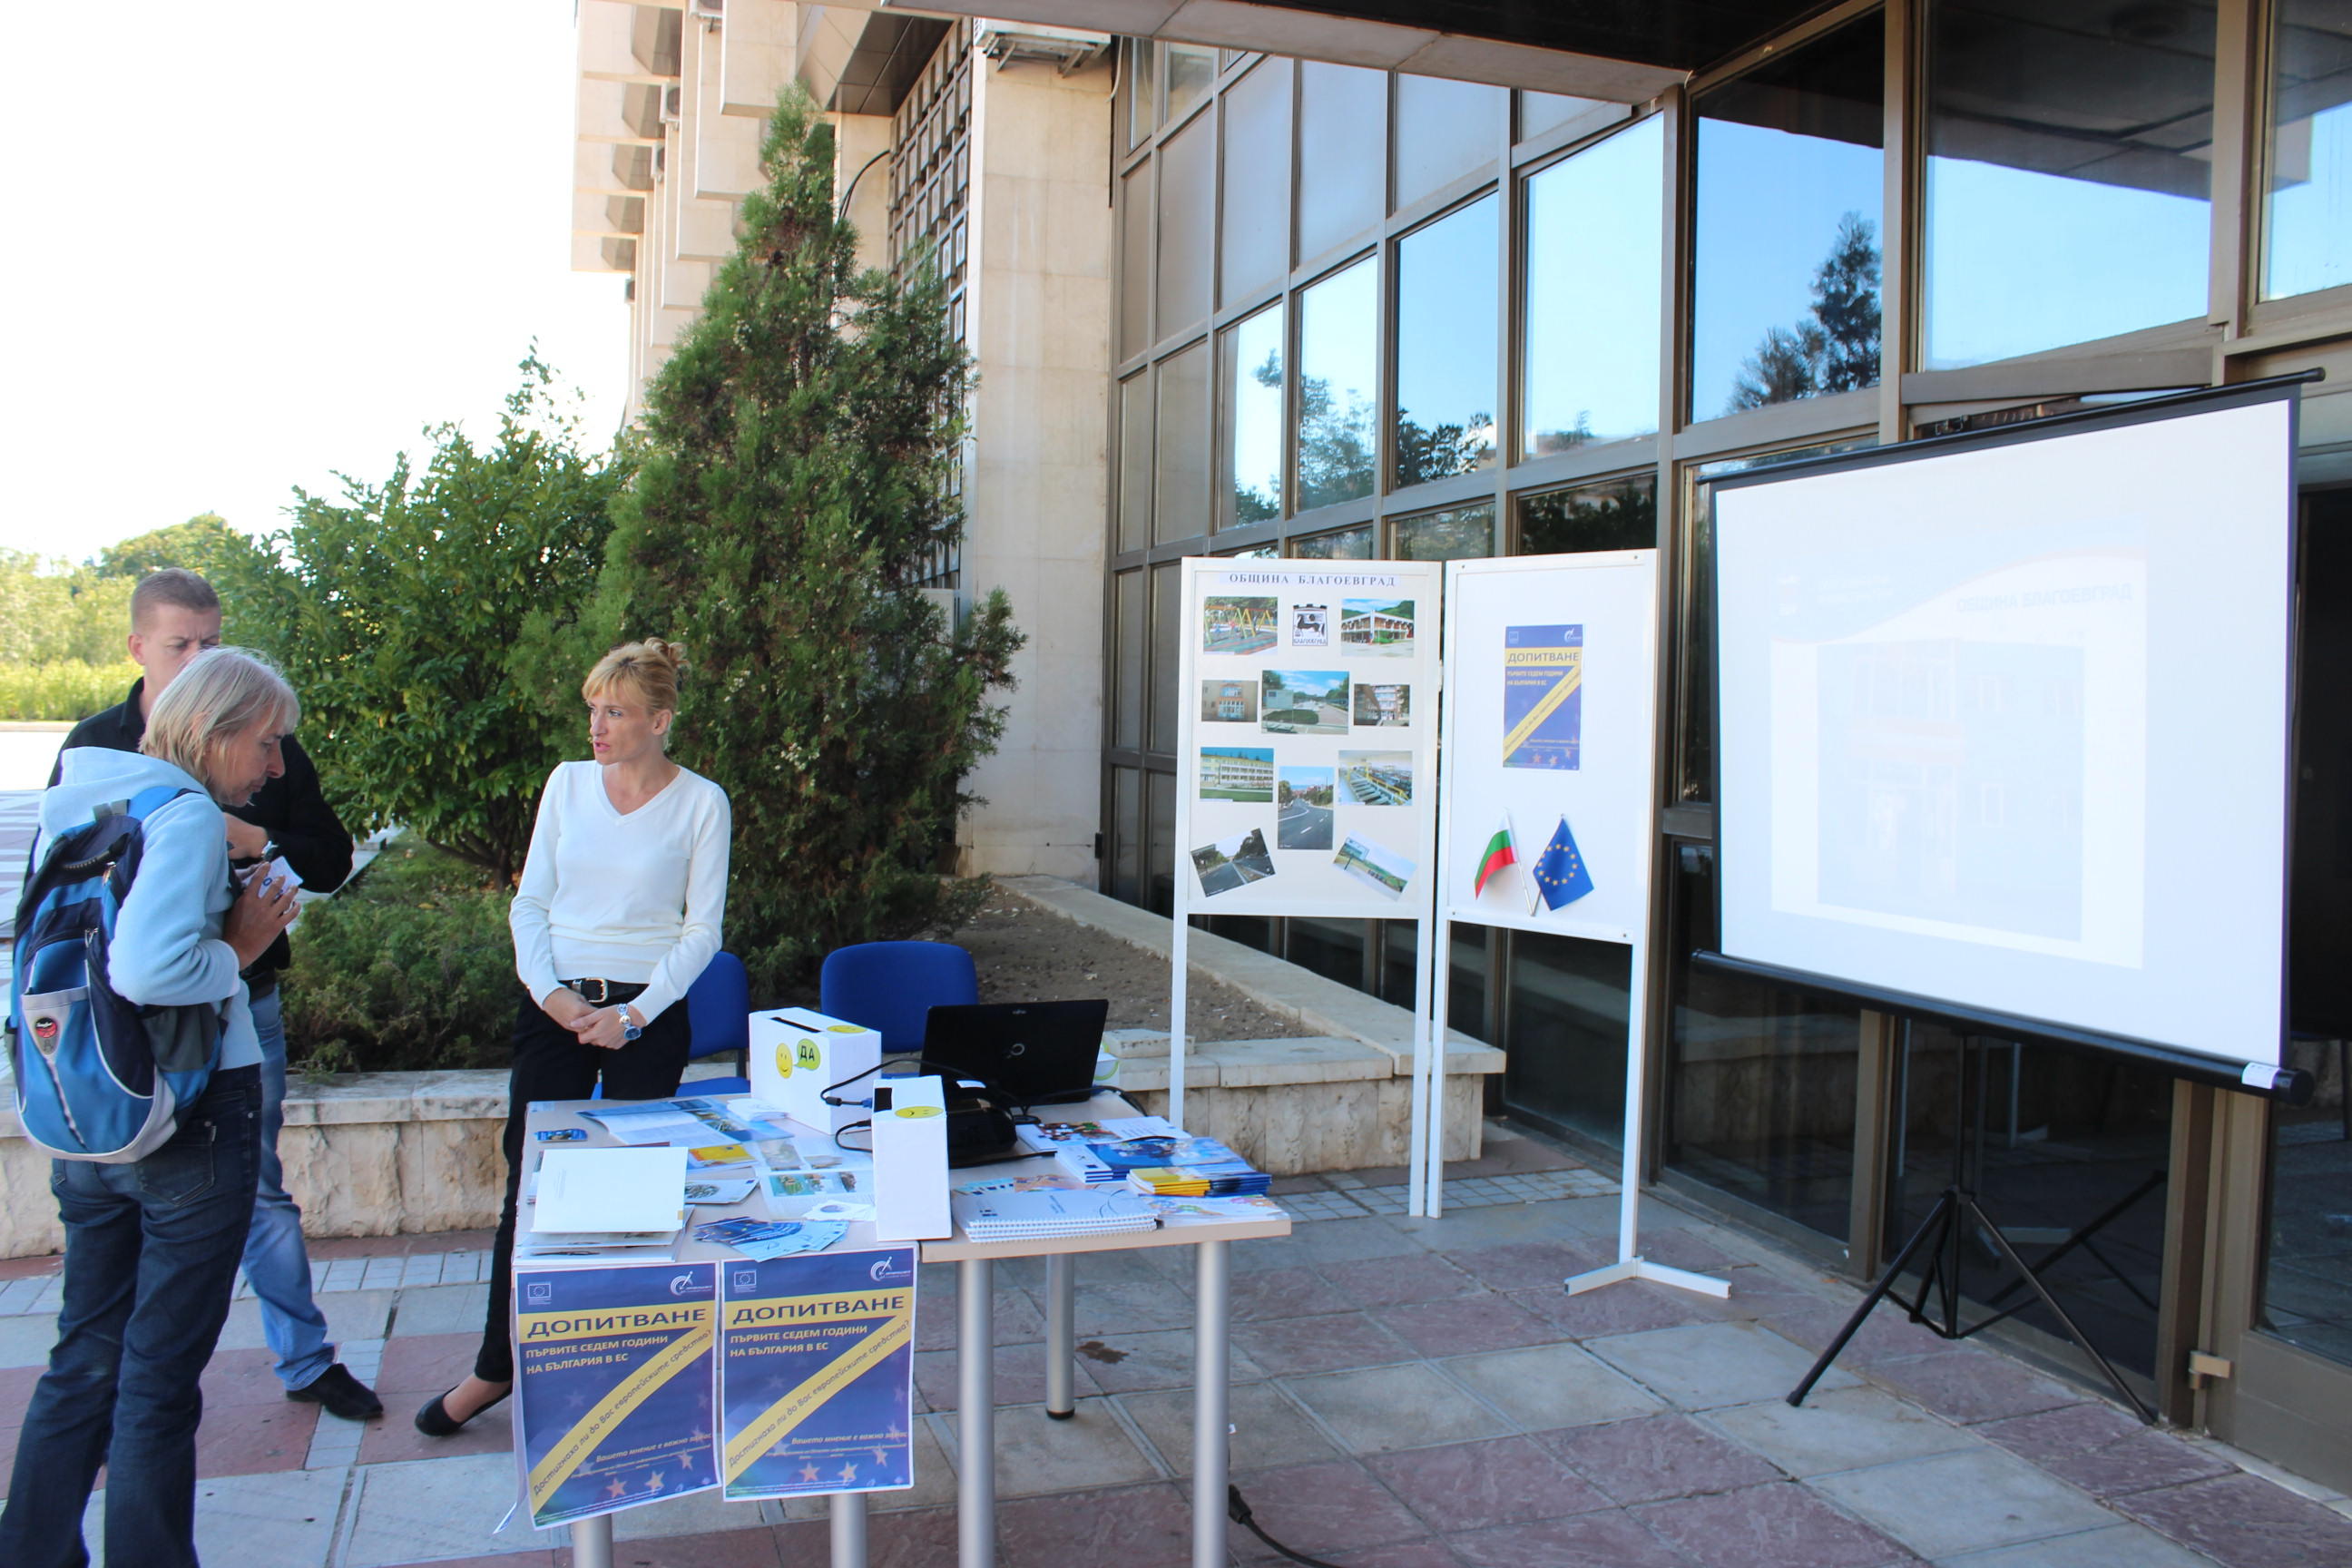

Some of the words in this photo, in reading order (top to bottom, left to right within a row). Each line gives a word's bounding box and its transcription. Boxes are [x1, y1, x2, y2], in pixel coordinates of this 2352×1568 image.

[1229, 573, 1289, 584] ОБЩИНА
[1298, 573, 1395, 587] БЛАГОЕВГРАД
[1507, 652, 1579, 664] ДОПИТВАНЕ
[799, 1044, 815, 1063] ДА
[732, 1296, 905, 1325] ДОПИТВАНЕ
[527, 1308, 706, 1338] ДОПИТВАНЕ
[730, 1332, 780, 1344] ПЪРВИТЕ
[782, 1328, 820, 1340] СЕДЕМ
[822, 1325, 867, 1338] ГОДИНИ
[524, 1344, 578, 1359] ПЪРВИТЕ
[580, 1339, 620, 1352] СЕДЕМ
[622, 1335, 669, 1348] ГОДИНИ
[730, 1348, 746, 1357] НА
[748, 1344, 805, 1357] БЪЛГАРИЯ
[807, 1343, 814, 1351] В
[816, 1341, 829, 1351] ЕС
[526, 1365, 544, 1376] НА
[544, 1356, 603, 1372] БЪЛГАРИЯ
[605, 1355, 612, 1364] В
[614, 1352, 629, 1363] ЕС
[589, 1422, 601, 1436] до
[599, 1408, 615, 1425] Вас
